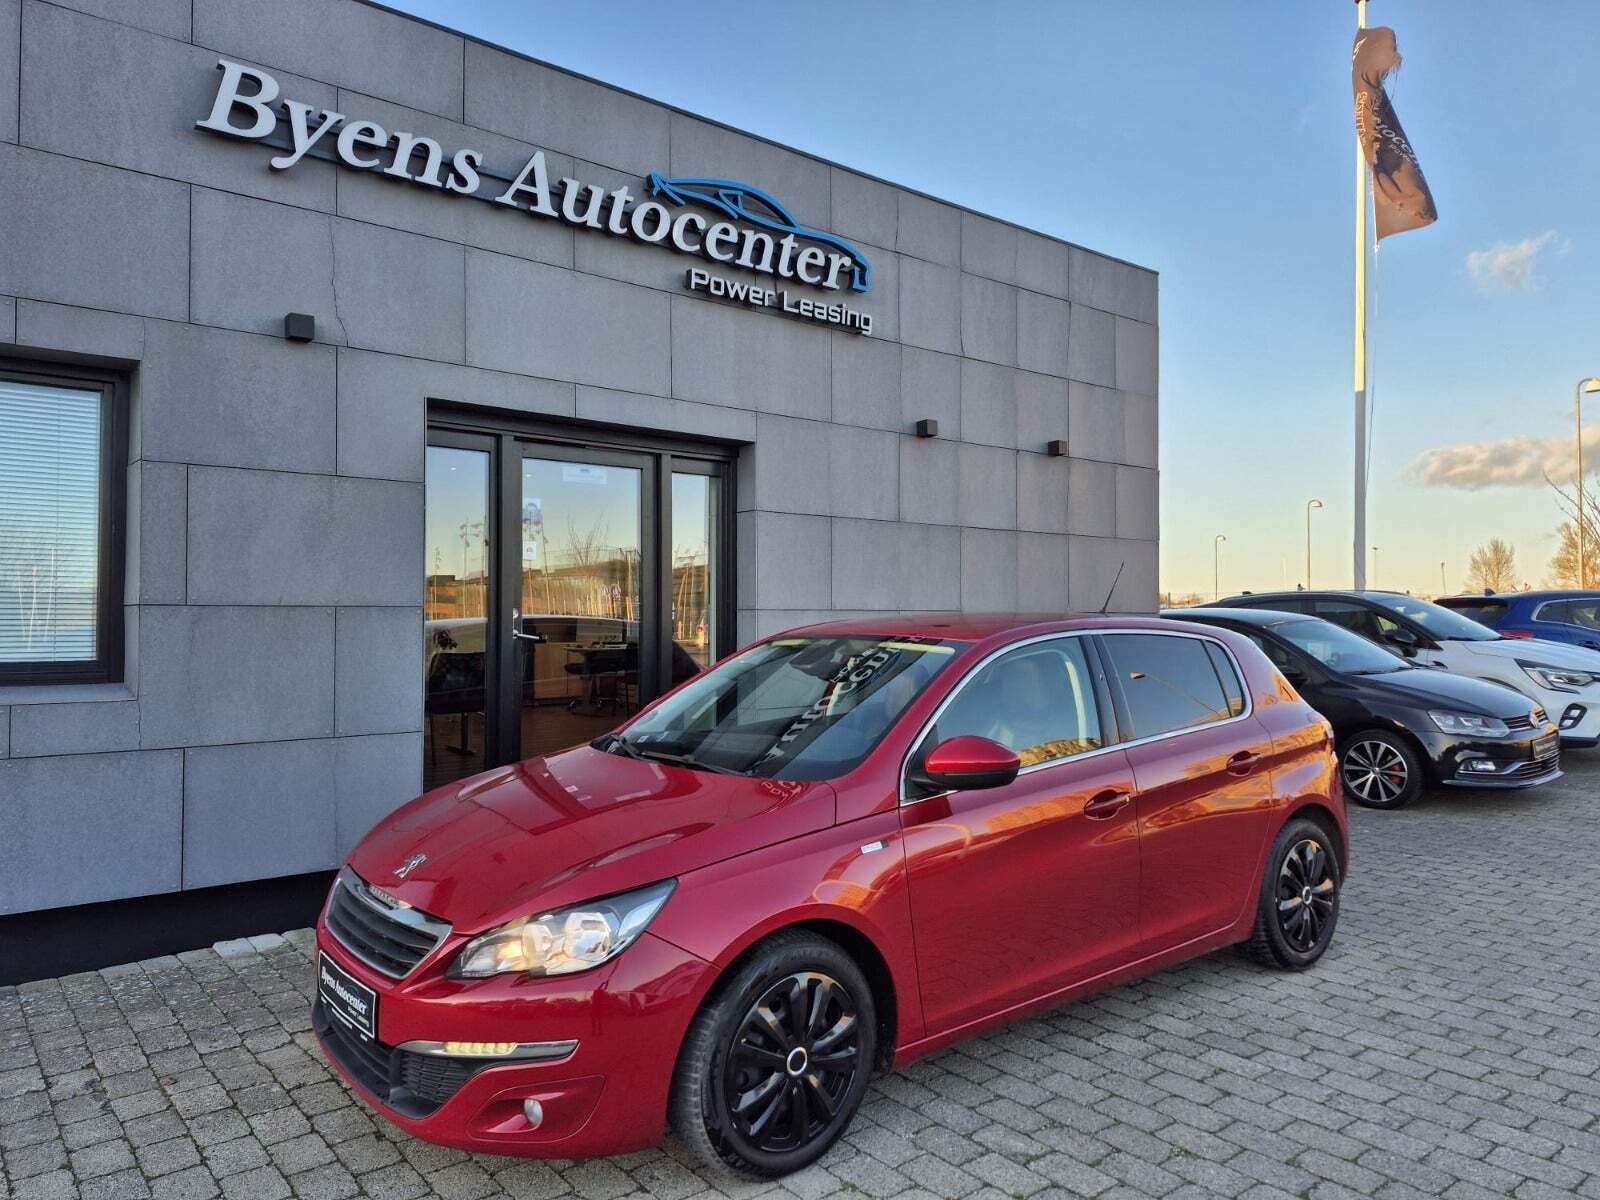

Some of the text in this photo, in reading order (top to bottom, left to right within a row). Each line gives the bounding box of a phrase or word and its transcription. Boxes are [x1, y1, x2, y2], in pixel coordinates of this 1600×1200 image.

[195, 59, 852, 291] Byens Autocenter
[689, 267, 873, 336] Power Leasing
[335, 980, 367, 1015] Autocenter
